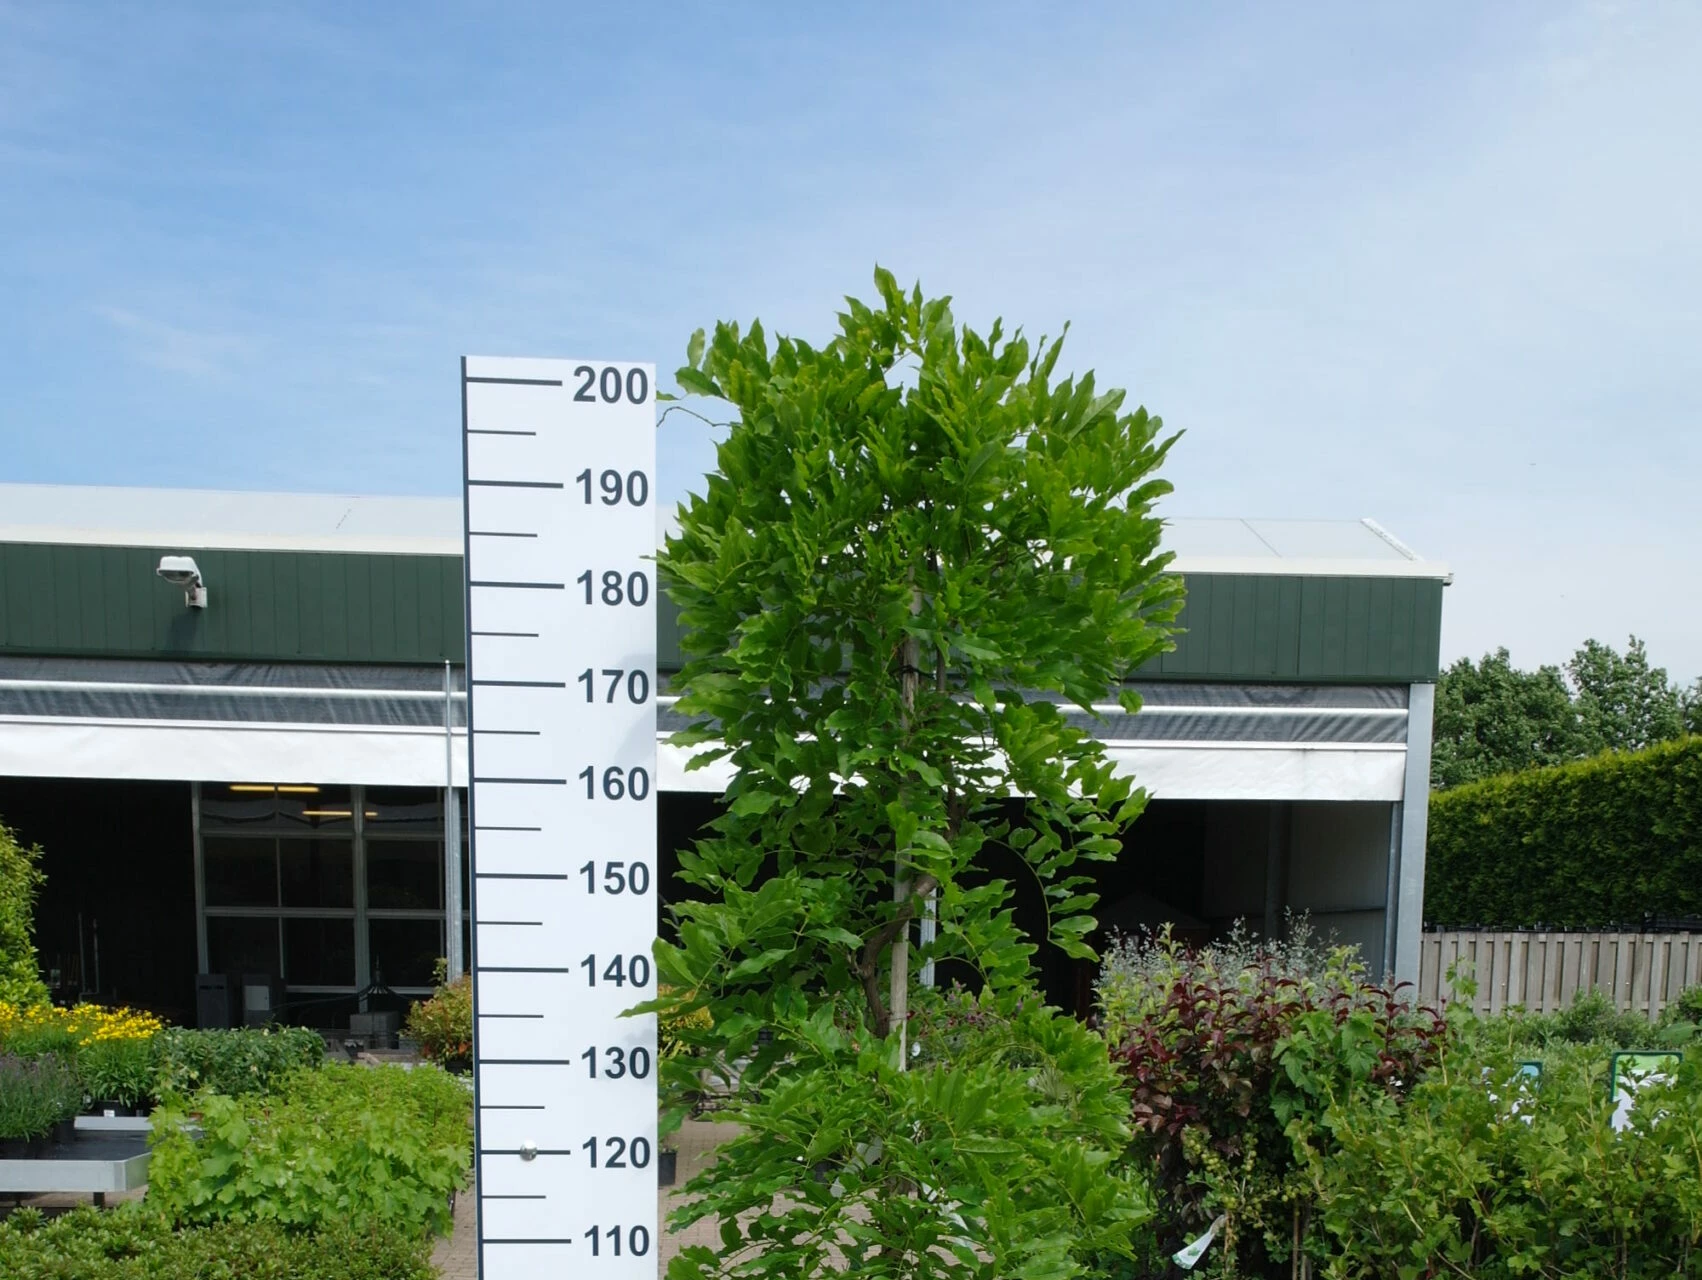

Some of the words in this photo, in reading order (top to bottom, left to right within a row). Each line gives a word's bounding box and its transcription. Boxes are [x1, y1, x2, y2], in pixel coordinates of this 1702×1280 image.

[573, 365, 648, 404] 200
[576, 468, 648, 506] 190
[576, 570, 649, 607] 180
[577, 668, 649, 704] 170
[578, 765, 649, 801] 160
[579, 861, 650, 895] 150
[580, 954, 650, 988] 140
[581, 1046, 651, 1079] 130
[583, 1136, 651, 1169] 120
[584, 1225, 650, 1257] 110
